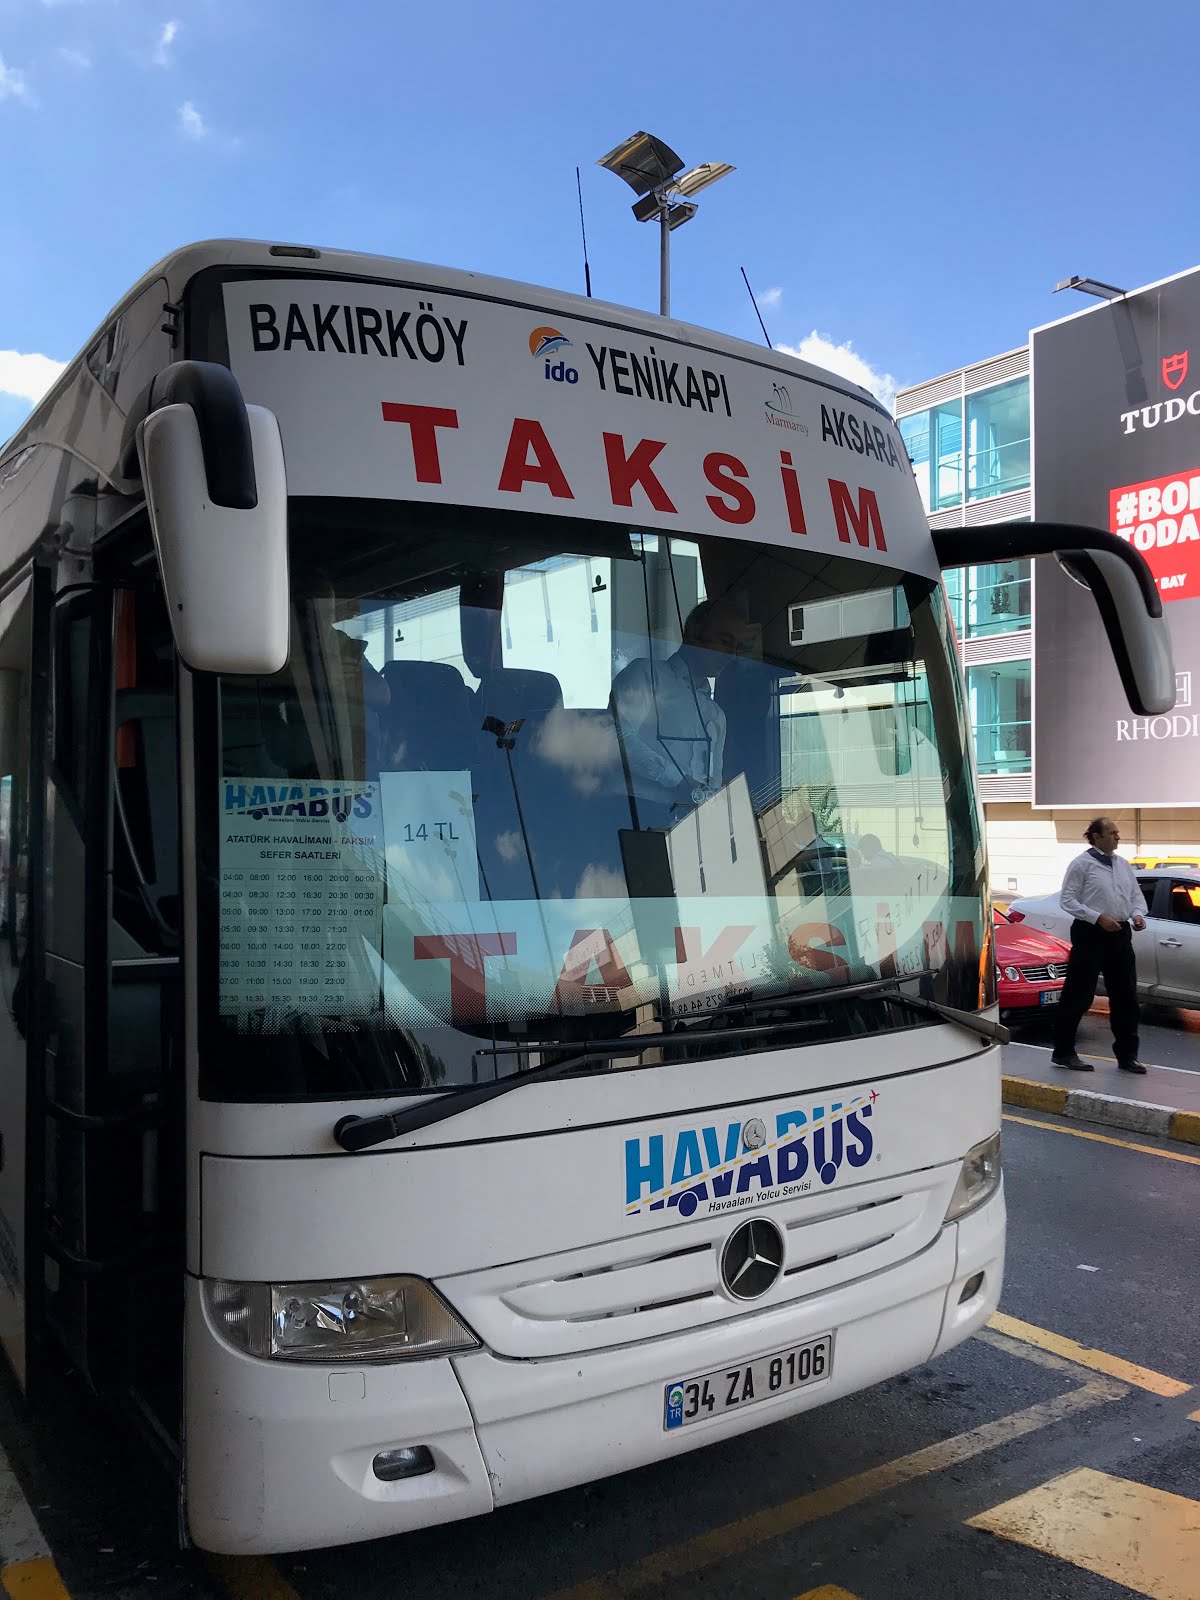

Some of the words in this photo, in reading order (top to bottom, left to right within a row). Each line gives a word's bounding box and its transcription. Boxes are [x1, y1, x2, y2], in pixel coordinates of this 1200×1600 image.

[249, 301, 468, 366] BAKIRKÖY
[545, 358, 579, 384] ido
[585, 343, 732, 417] YENİKAPI
[764, 412, 809, 437] Marmaray
[381, 401, 888, 552] TAKSİM
[1160, 573, 1187, 590] BAY
[226, 833, 270, 844] ATATÜRK
[273, 834, 332, 845] HAVALİMANI
[340, 834, 375, 846] TAKSİM
[403, 823, 429, 842] 14
[434, 822, 459, 841] TL
[260, 851, 292, 859] SEFER
[294, 850, 341, 860] SAATLERİ
[625, 1097, 874, 1216] HAVABUS
[708, 1195, 754, 1213] Havaalanı
[756, 1190, 780, 1203] Yolcu
[782, 1179, 812, 1197] Servisi
[684, 1379, 716, 1418] 34
[725, 1366, 755, 1406] ZA
[769, 1343, 825, 1391] 8106
[670, 1408, 682, 1420] TR
